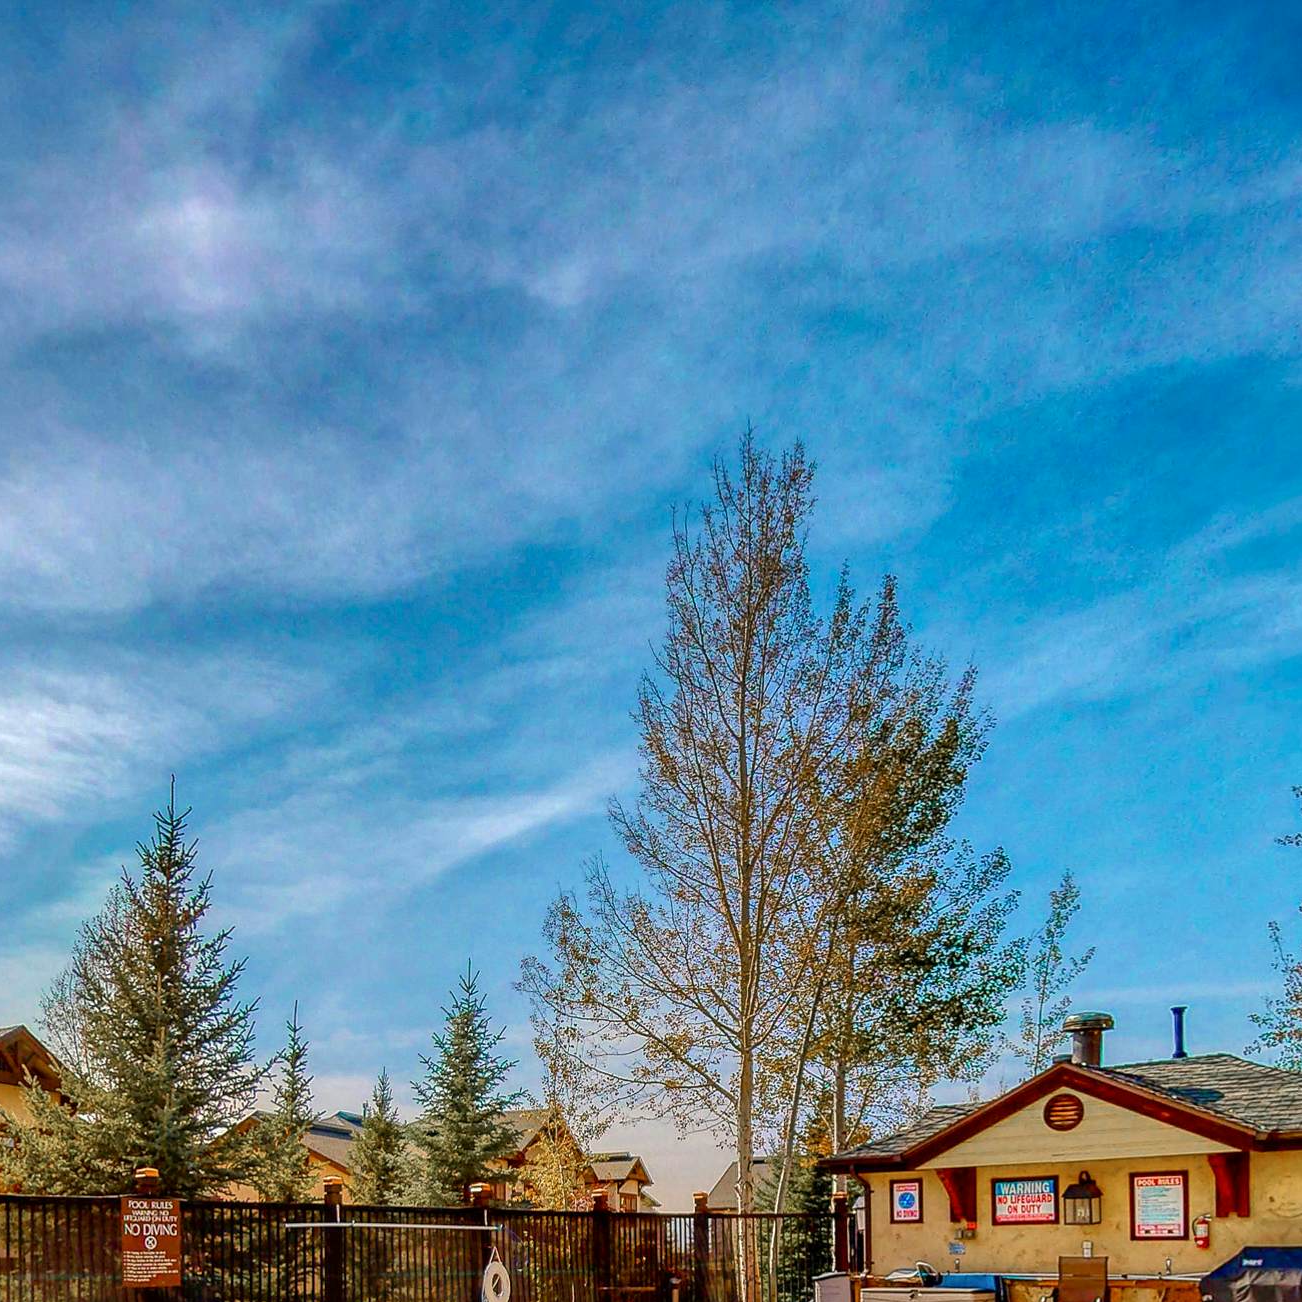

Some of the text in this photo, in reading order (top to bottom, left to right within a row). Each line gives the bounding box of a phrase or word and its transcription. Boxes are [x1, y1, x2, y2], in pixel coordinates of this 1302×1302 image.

[1001, 1181, 1050, 1194] WARNING
[1010, 1194, 1052, 1204] LIFEGUARD
[128, 1200, 173, 1209] POOL RULES
[1007, 1204, 1041, 1213] ON DUTY
[124, 1223, 178, 1236] NO DIVING
